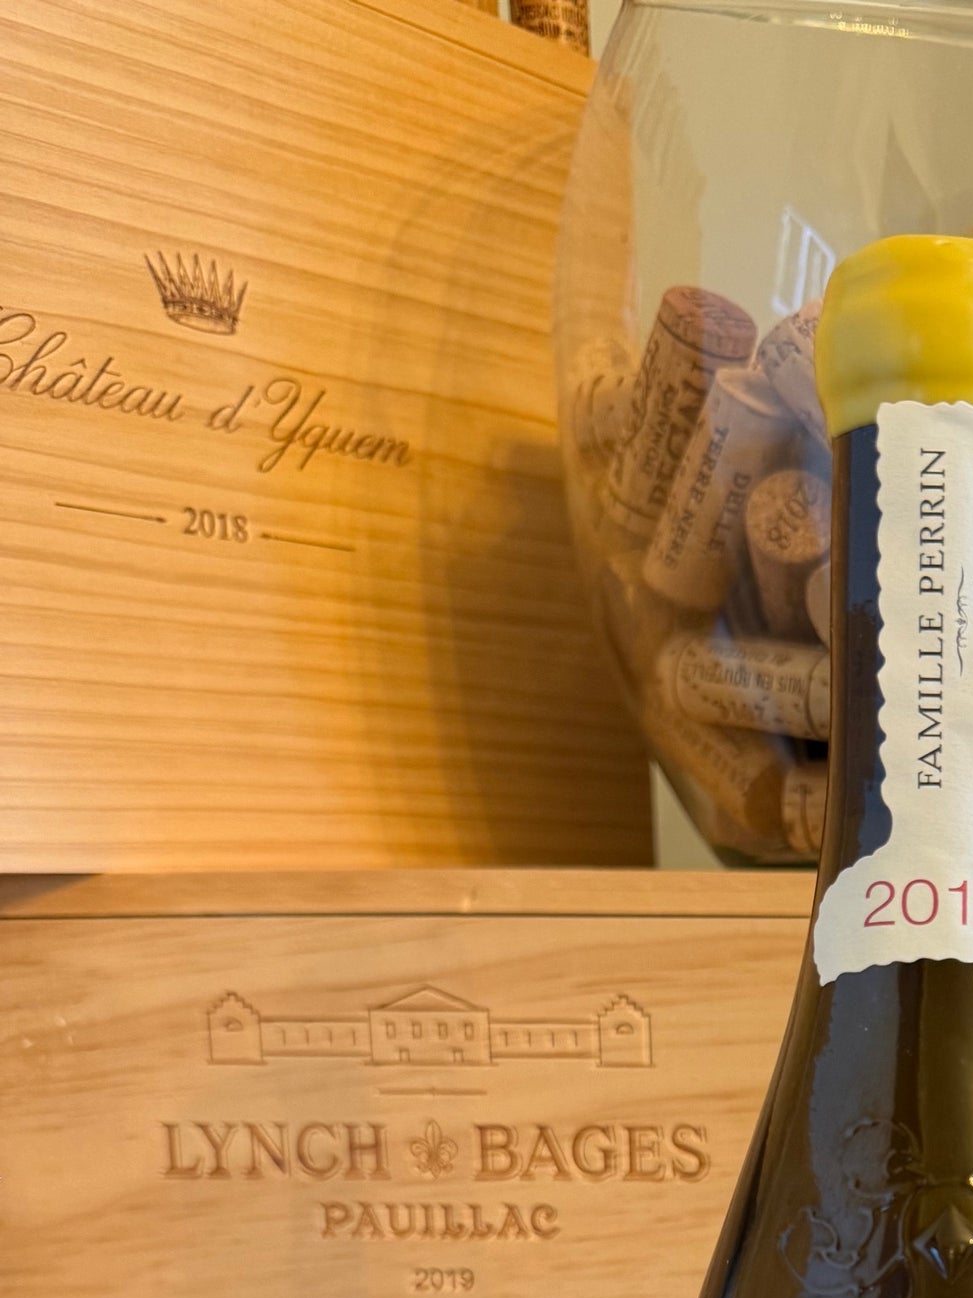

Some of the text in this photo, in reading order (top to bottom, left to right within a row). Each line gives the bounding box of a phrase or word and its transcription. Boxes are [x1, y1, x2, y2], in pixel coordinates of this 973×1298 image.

[205, 378, 411, 473] d'Yquem
[183, 506, 249, 543] 2018
[918, 447, 947, 789] FAMILLE PERRIN
[160, 1121, 711, 1182] LYNCH BAGES
[321, 1201, 561, 1240] PAUILLAC
[414, 1267, 475, 1292] 2019
